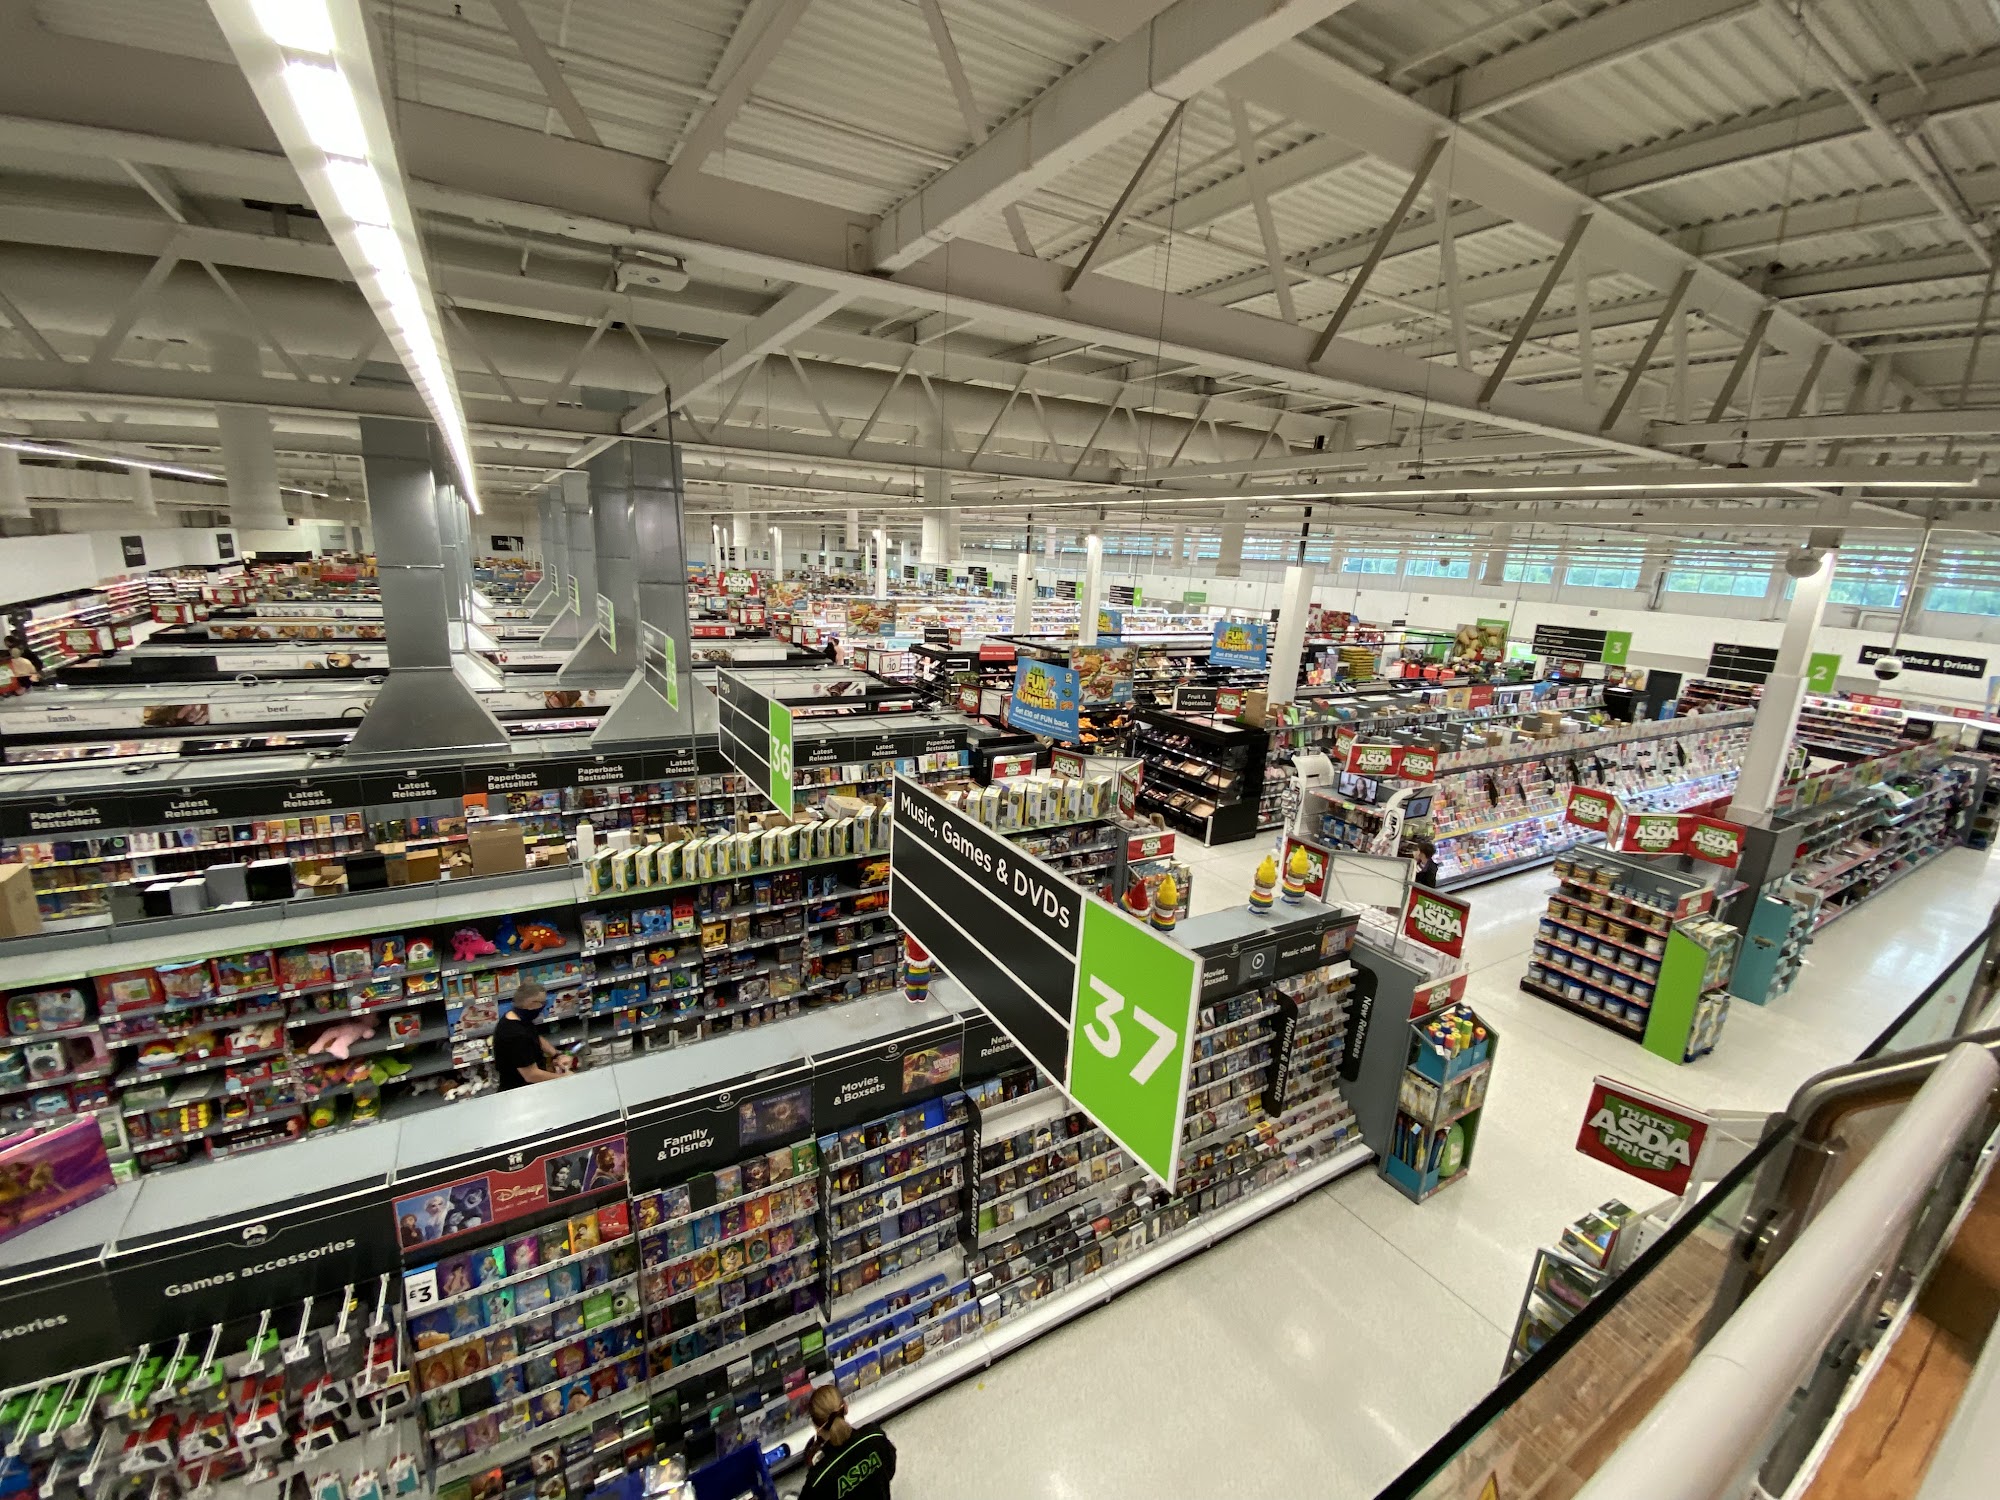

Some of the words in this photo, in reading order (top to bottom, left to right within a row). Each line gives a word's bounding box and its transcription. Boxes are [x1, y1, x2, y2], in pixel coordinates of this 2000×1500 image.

[723, 577, 754, 587] ASDA
[1226, 630, 1245, 642] FUN
[1534, 646, 1549, 655] Party
[1612, 641, 1622, 654] 3
[1932, 659, 1941, 667] &
[1943, 660, 1980, 672] Drinks
[1812, 666, 1828, 680] 2
[1026, 673, 1047, 691] FUN
[1016, 689, 1057, 710] SUMMER
[266, 705, 289, 714] beef
[47, 714, 77, 723] lamb
[1015, 706, 1023, 714] Get
[1033, 711, 1040, 720] of
[1040, 714, 1053, 725] FUN
[1054, 718, 1070, 728] back
[808, 753, 837, 762] Releases
[812, 747, 834, 755] Latest
[871, 748, 898, 757] Releases
[670, 758, 695, 766] Latest
[772, 735, 790, 781] 36
[1058, 757, 1076, 765] THAT'S
[1356, 755, 1392, 766] ASDA
[1401, 757, 1434, 771] ASDA
[577, 765, 623, 776] Paperback
[665, 766, 699, 775] Releases
[1053, 761, 1080, 777] ASDA
[487, 772, 537, 783] Paperback
[577, 772, 624, 782] Bestsellers
[398, 781, 430, 790] Latest
[487, 779, 538, 790] Bestsellers
[288, 789, 324, 800] Latest
[392, 788, 437, 799] Releases
[170, 799, 209, 810] Latest
[283, 797, 332, 808] Releases
[1580, 796, 1602, 806] THAT'S
[30, 807, 99, 821] Paperback
[164, 807, 219, 819] Releases
[1569, 800, 1608, 819] ASDA
[31, 816, 101, 830] Bestsellers
[1575, 811, 1600, 823] PRICE
[1646, 819, 1672, 827] THAT'S
[1633, 825, 1679, 841] ASDA
[1141, 840, 1161, 852] ASDA
[1640, 839, 1670, 847] PRICE
[1690, 831, 1738, 854] ASDA
[1698, 844, 1729, 856] PRICE
[901, 792, 939, 838] Music,
[942, 820, 994, 874] Games
[996, 858, 1009, 888] &
[1014, 873, 1071, 930] DVDs
[1425, 900, 1454, 918] THAT'S
[1410, 903, 1463, 938] ASDA
[1418, 923, 1452, 942] PRICE
[1281, 948, 1300, 959] Music
[1300, 943, 1316, 954] chart
[1203, 975, 1229, 987] Boxsets
[1427, 987, 1451, 1006] ASDA
[1360, 995, 1372, 1018] New
[1082, 973, 1179, 1086] 37
[1282, 1017, 1296, 1053] Movies
[1352, 1018, 1367, 1060] Releases
[1280, 1054, 1289, 1062] &
[841, 1074, 879, 1094] Movies
[1274, 1063, 1287, 1103] Boxsets
[833, 1096, 842, 1106] &
[844, 1083, 886, 1104] Boxsets
[716, 1101, 734, 1110] watch
[663, 1127, 709, 1149] Family
[657, 1150, 667, 1161] &
[670, 1136, 715, 1159] Disney
[973, 1129, 981, 1175] Movies
[493, 1184, 544, 1202] Disney
[970, 1188, 980, 1238] Boxsets
[164, 1270, 236, 1297] Games
[241, 1237, 356, 1278] accessories
[409, 1285, 432, 1303] £3
[838, 1451, 882, 1500] ASDA
